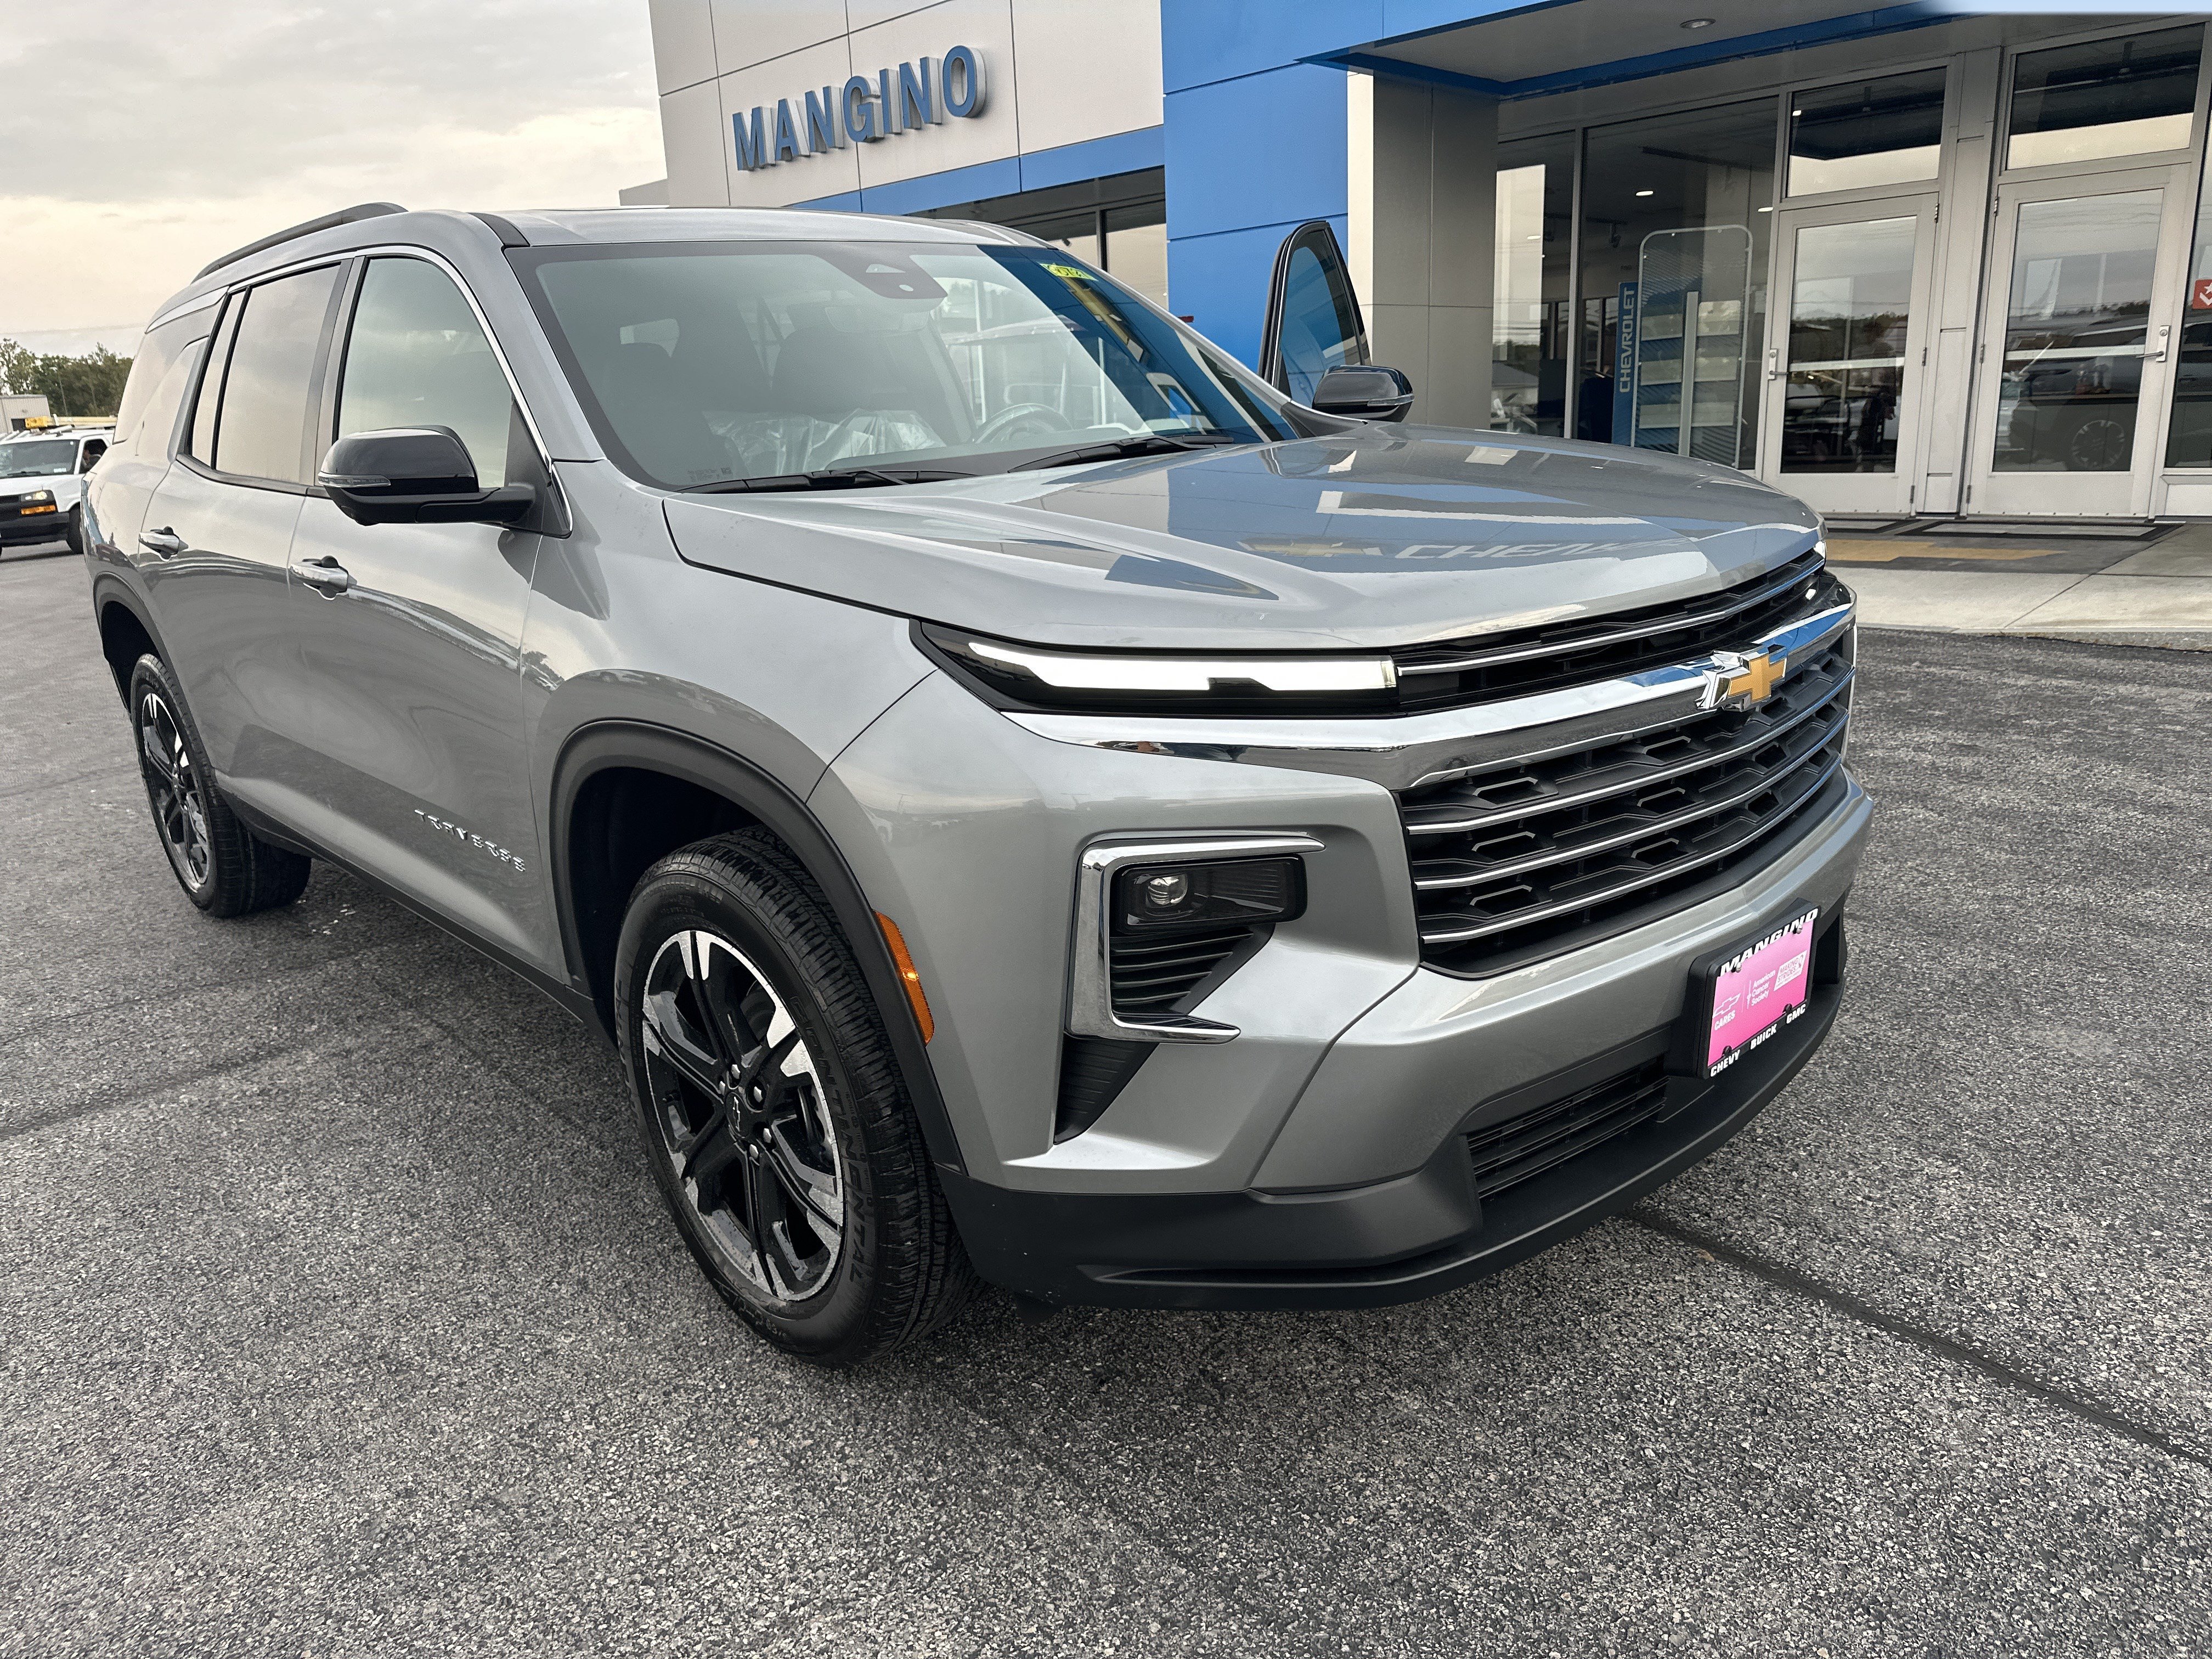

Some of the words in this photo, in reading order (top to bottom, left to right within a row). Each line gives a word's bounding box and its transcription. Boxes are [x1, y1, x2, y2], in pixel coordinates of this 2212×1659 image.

[732, 45, 986, 171] MANGINO
[1620, 287, 1634, 393] CHEVROLET
[1719, 908, 1819, 977] MANGINO
[1710, 1049, 1740, 1077] CHEVY
[1750, 1023, 1778, 1050] BUICK
[1786, 1004, 1807, 1024] GMC
[1714, 1009, 1736, 1031] CARES
